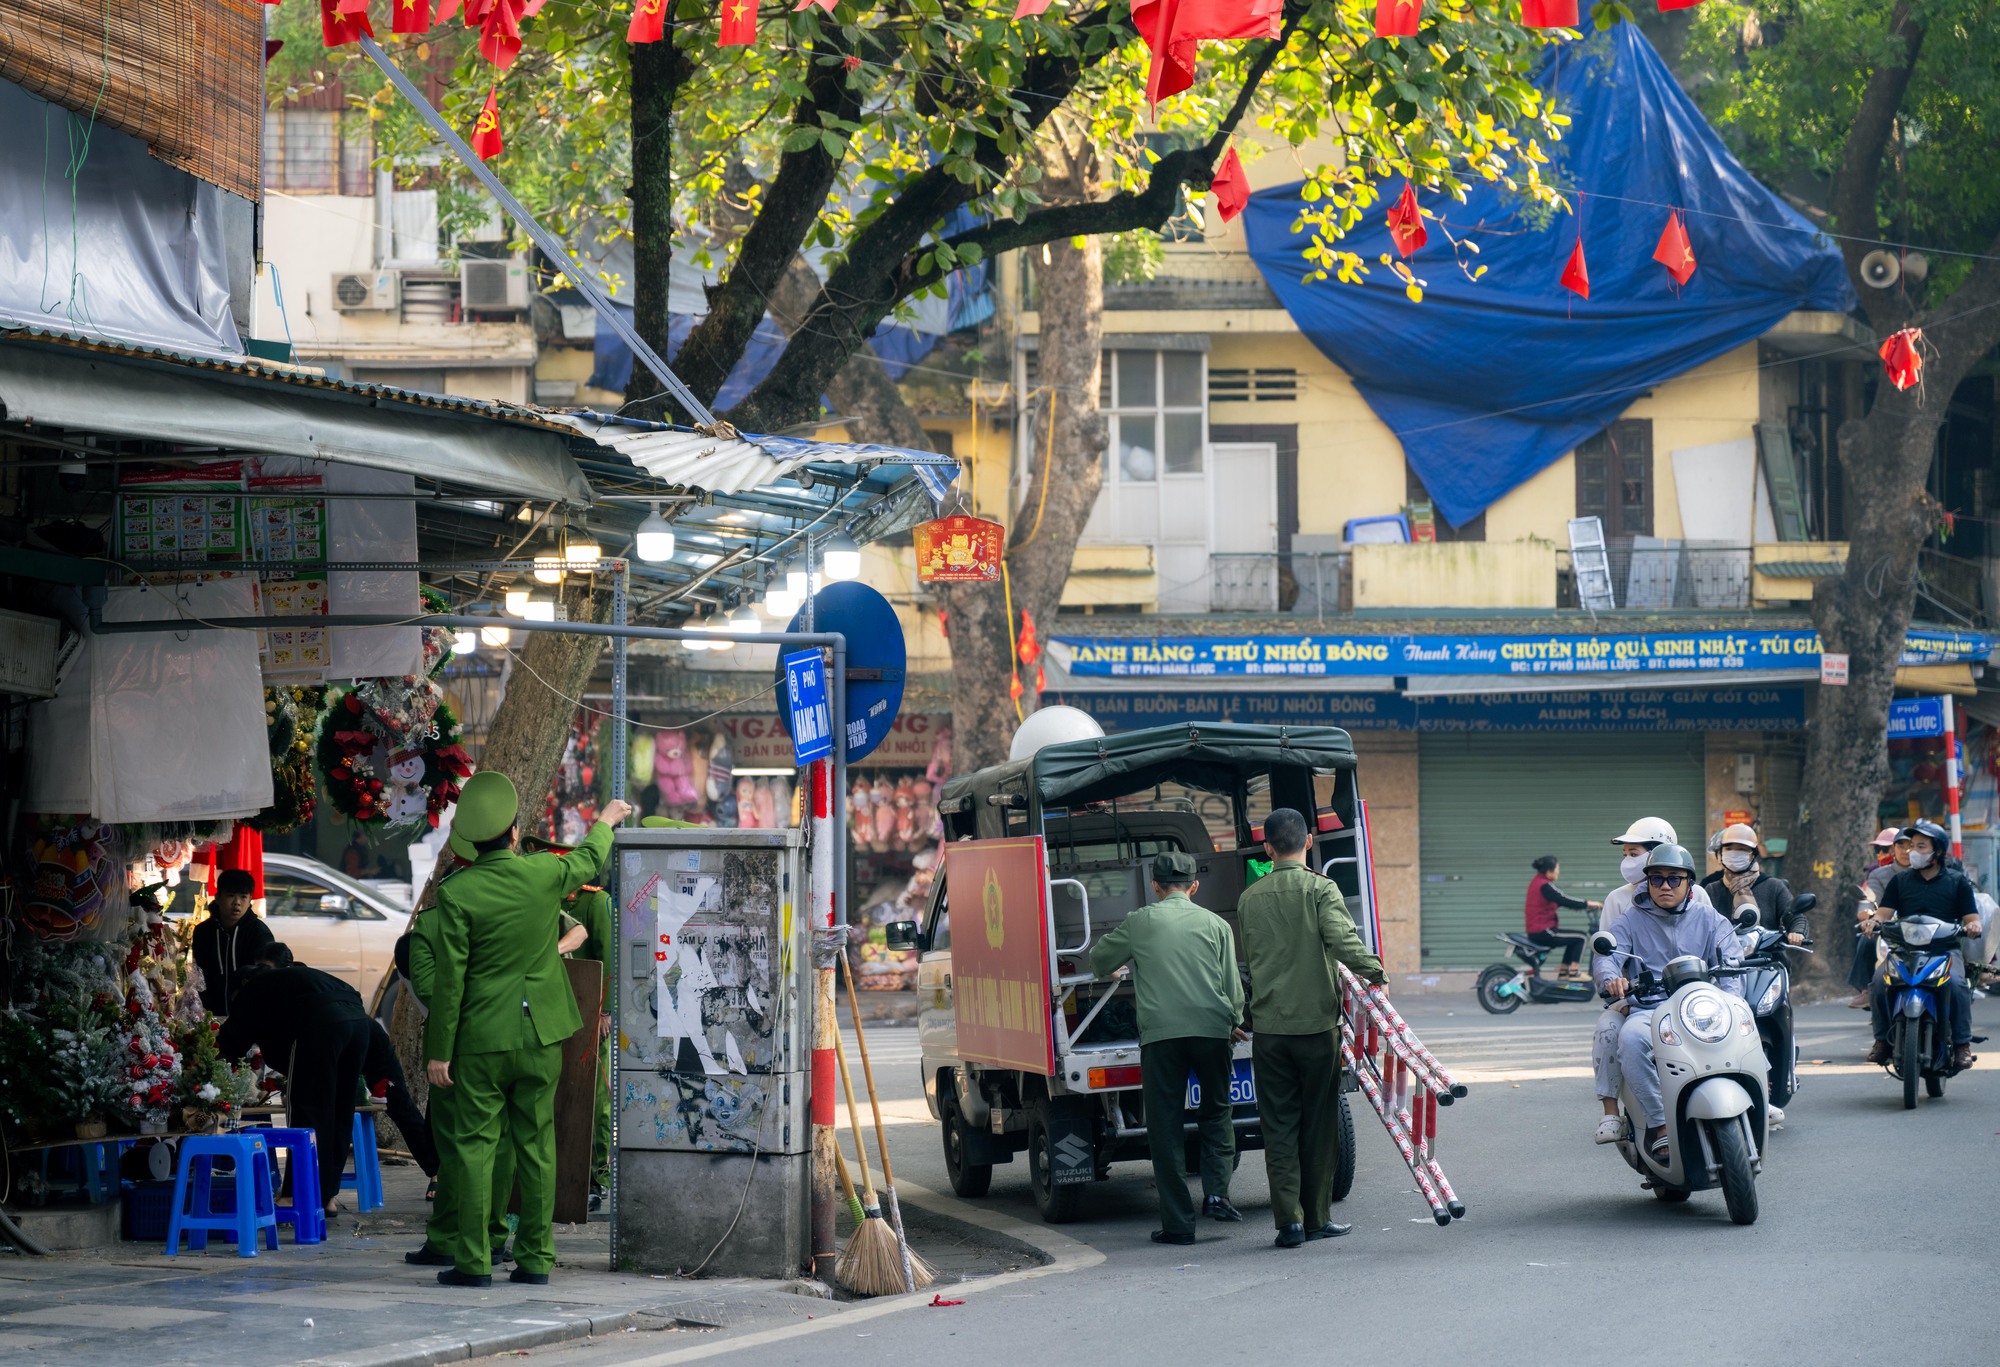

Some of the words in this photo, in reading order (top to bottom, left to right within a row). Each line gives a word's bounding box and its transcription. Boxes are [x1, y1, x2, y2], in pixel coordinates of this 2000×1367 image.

[1211, 640, 1259, 661] THÚ
[1326, 640, 1389, 661] BÔNG
[1403, 644, 1451, 662] Thanh
[1501, 638, 1572, 660] CHUYÊN
[1576, 637, 1610, 661] HỘP
[1654, 640, 1695, 657] SINH
[1699, 635, 1747, 660] NHẬT
[1760, 634, 1789, 655] TÚI
[1550, 658, 1574, 672] PHỐ
[1576, 658, 1608, 671] HÀNG
[1610, 657, 1640, 671] LƯỢC
[802, 661, 816, 689] PHỐ
[1096, 694, 1129, 713] BÁN
[1247, 694, 1279, 713] THÚ
[1331, 694, 1376, 713] BÔNG
[1538, 709, 1591, 720] ALBUM
[1627, 705, 1666, 720] SÁCH
[1897, 701, 1919, 713] PHỐ
[794, 699, 817, 745] HÀNG
[846, 718, 866, 736] ROAD
[1909, 716, 1937, 732] LƯỢC
[847, 732, 868, 750] TRAP
[744, 744, 769, 757] BÁN
[1813, 859, 1835, 880] 45
[1055, 1168, 1092, 1177] SUZUKI
